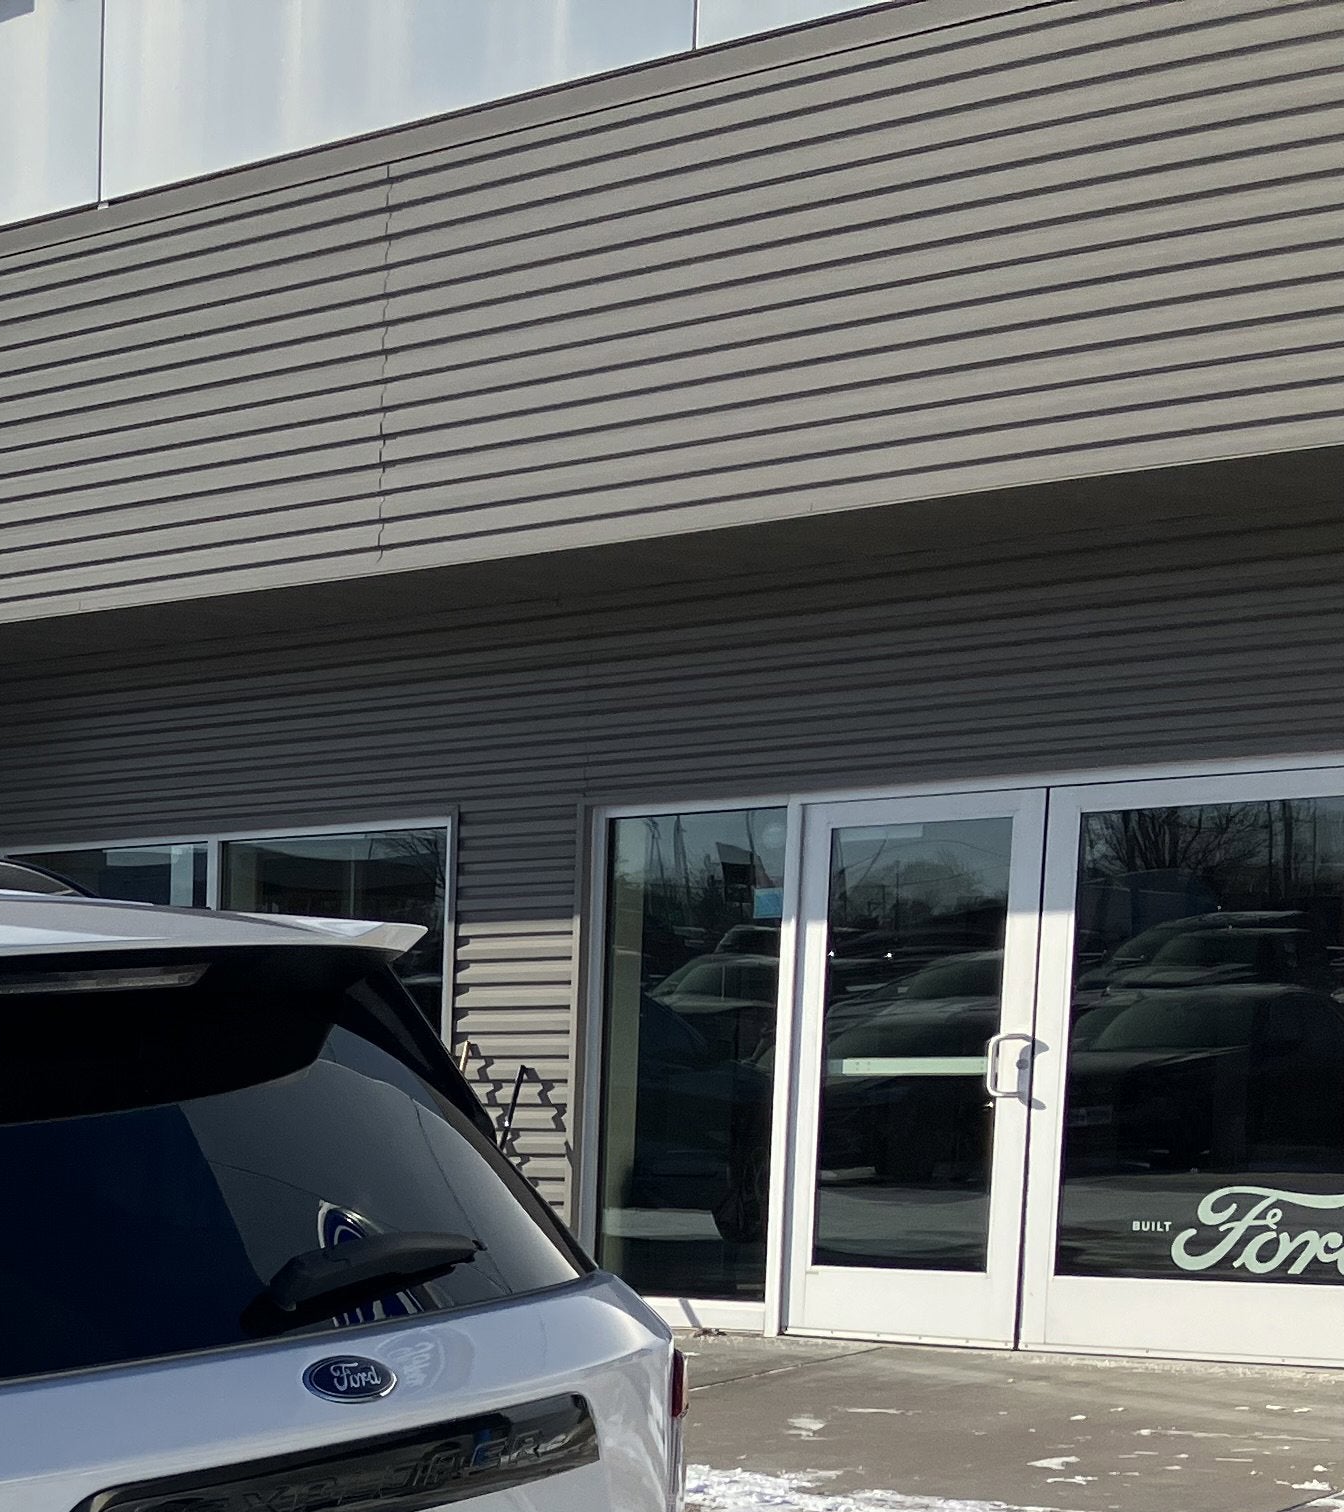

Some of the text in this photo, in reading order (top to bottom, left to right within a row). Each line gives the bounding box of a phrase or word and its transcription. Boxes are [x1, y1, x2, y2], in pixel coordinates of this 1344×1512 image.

[1132, 1186, 1344, 1275] BUILT For
[330, 1362, 381, 1391] Ford
